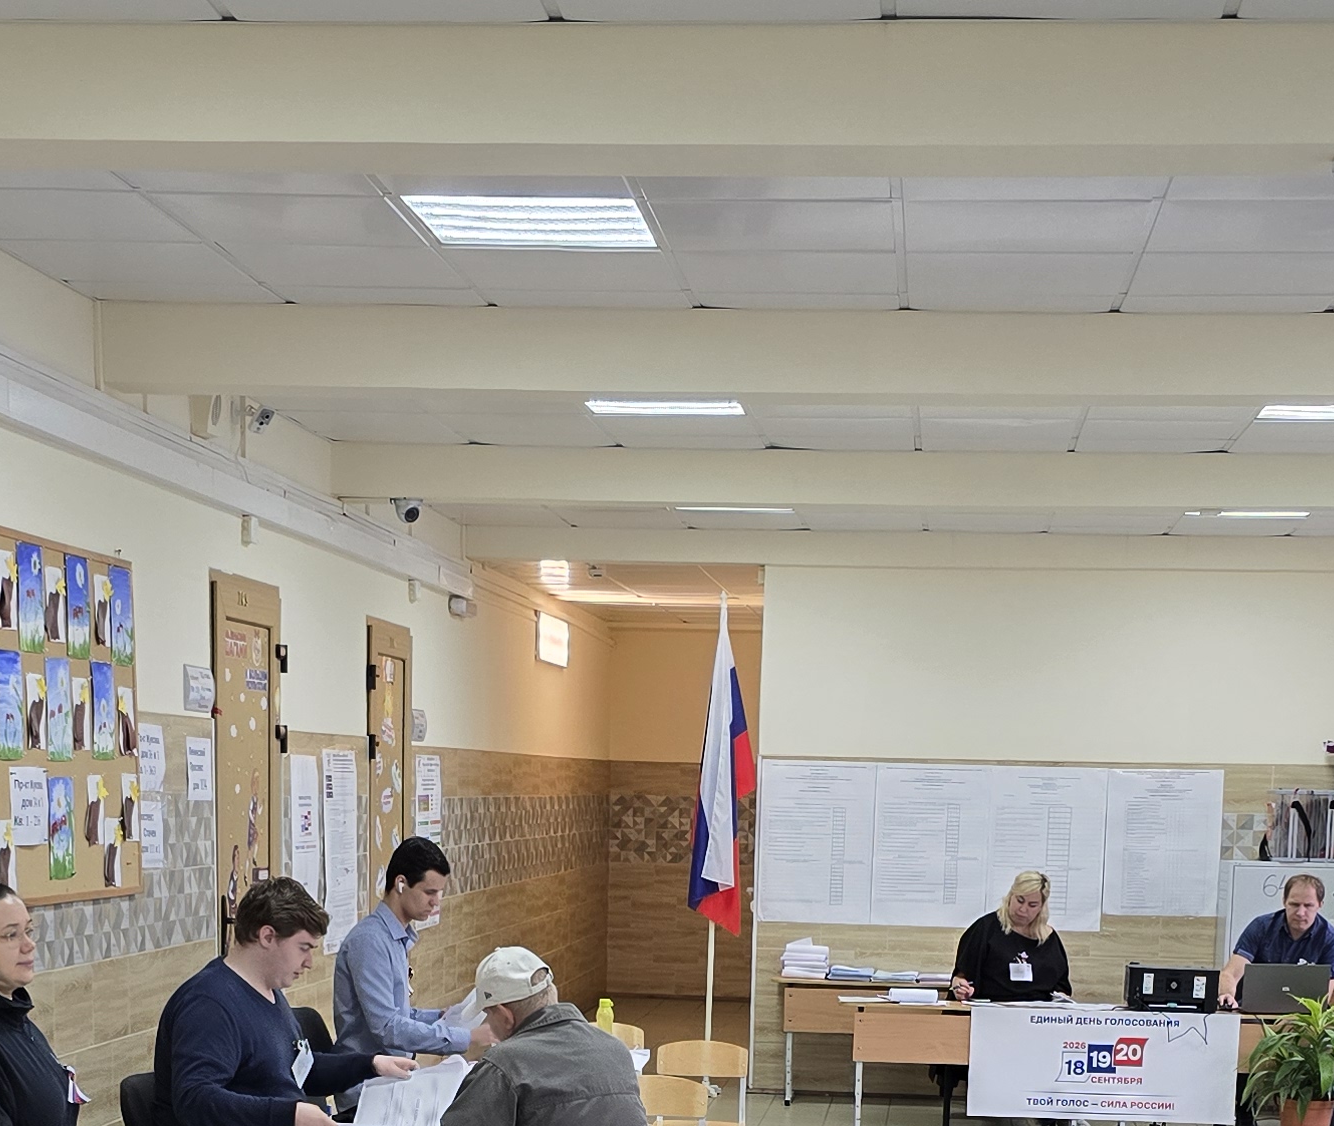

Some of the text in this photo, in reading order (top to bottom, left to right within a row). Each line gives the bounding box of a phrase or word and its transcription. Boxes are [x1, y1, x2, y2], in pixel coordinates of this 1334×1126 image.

[1030, 1015, 1180, 1028] ЕДИНЫЙ ДЕНЬ ГОЛОСОВАНИЯ
[1062, 1041, 1086, 1050] 2026
[1116, 1044, 1142, 1061] 20
[1090, 1051, 1111, 1068] 19
[1065, 1060, 1085, 1076] 18
[1091, 1077, 1143, 1085] СЕНТЯБРЯ
[1026, 1097, 1054, 1108] ТВОЙ
[1055, 1099, 1089, 1108] ГОЛОС
[1100, 1100, 1128, 1109] СИЛА
[1130, 1101, 1175, 1111] РОССИИ!
